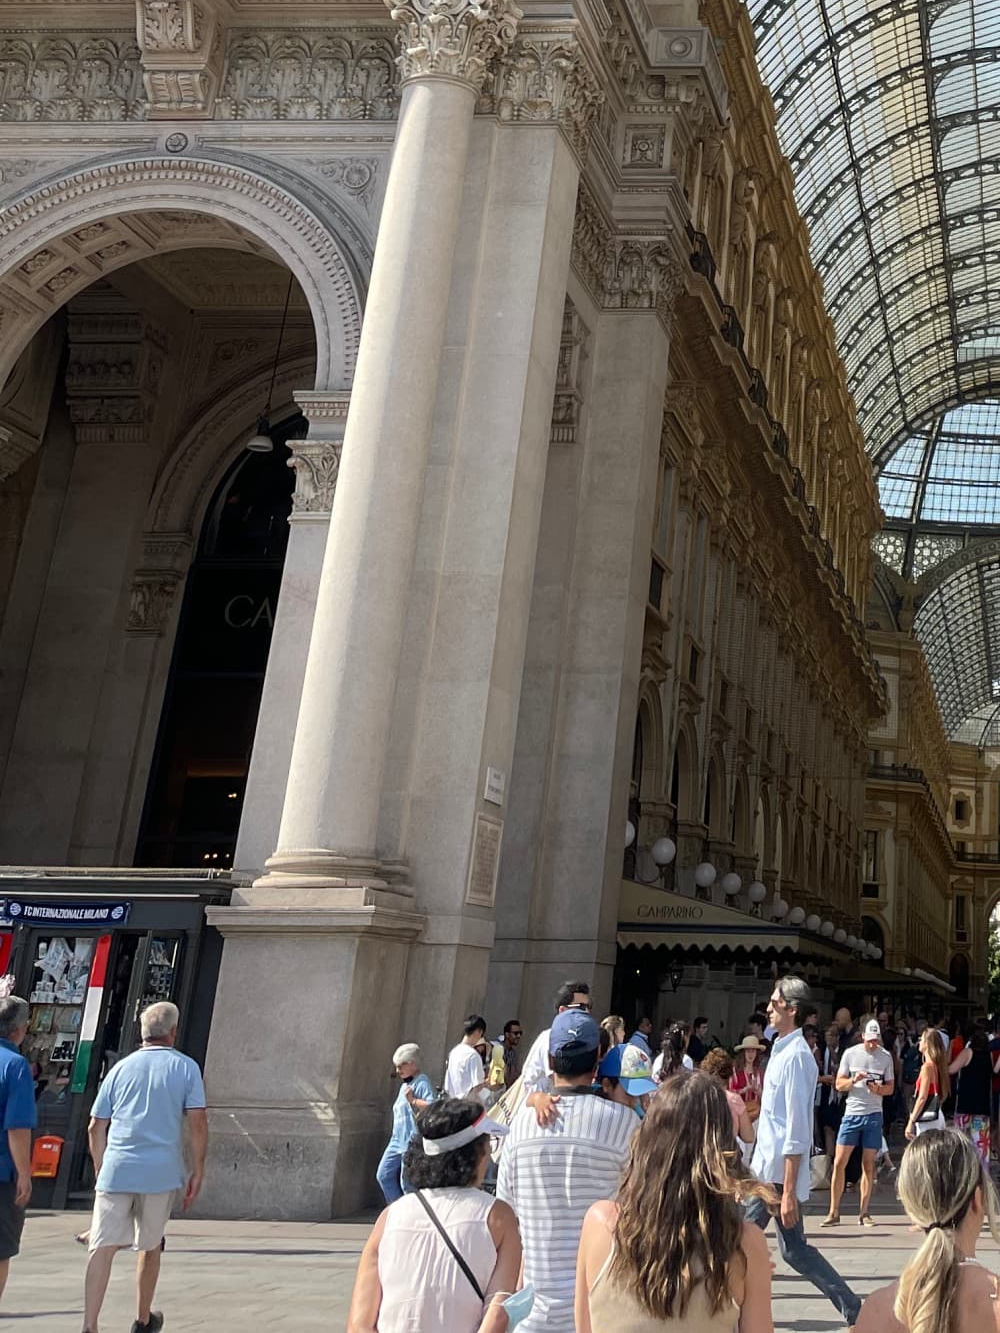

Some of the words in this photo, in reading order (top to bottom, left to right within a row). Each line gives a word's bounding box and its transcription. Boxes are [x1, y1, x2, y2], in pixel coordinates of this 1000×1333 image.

[33, 907, 84, 919] INTERNAZIONALE
[84, 909, 108, 919] MILANO
[637, 904, 704, 919] CAMPARINO
